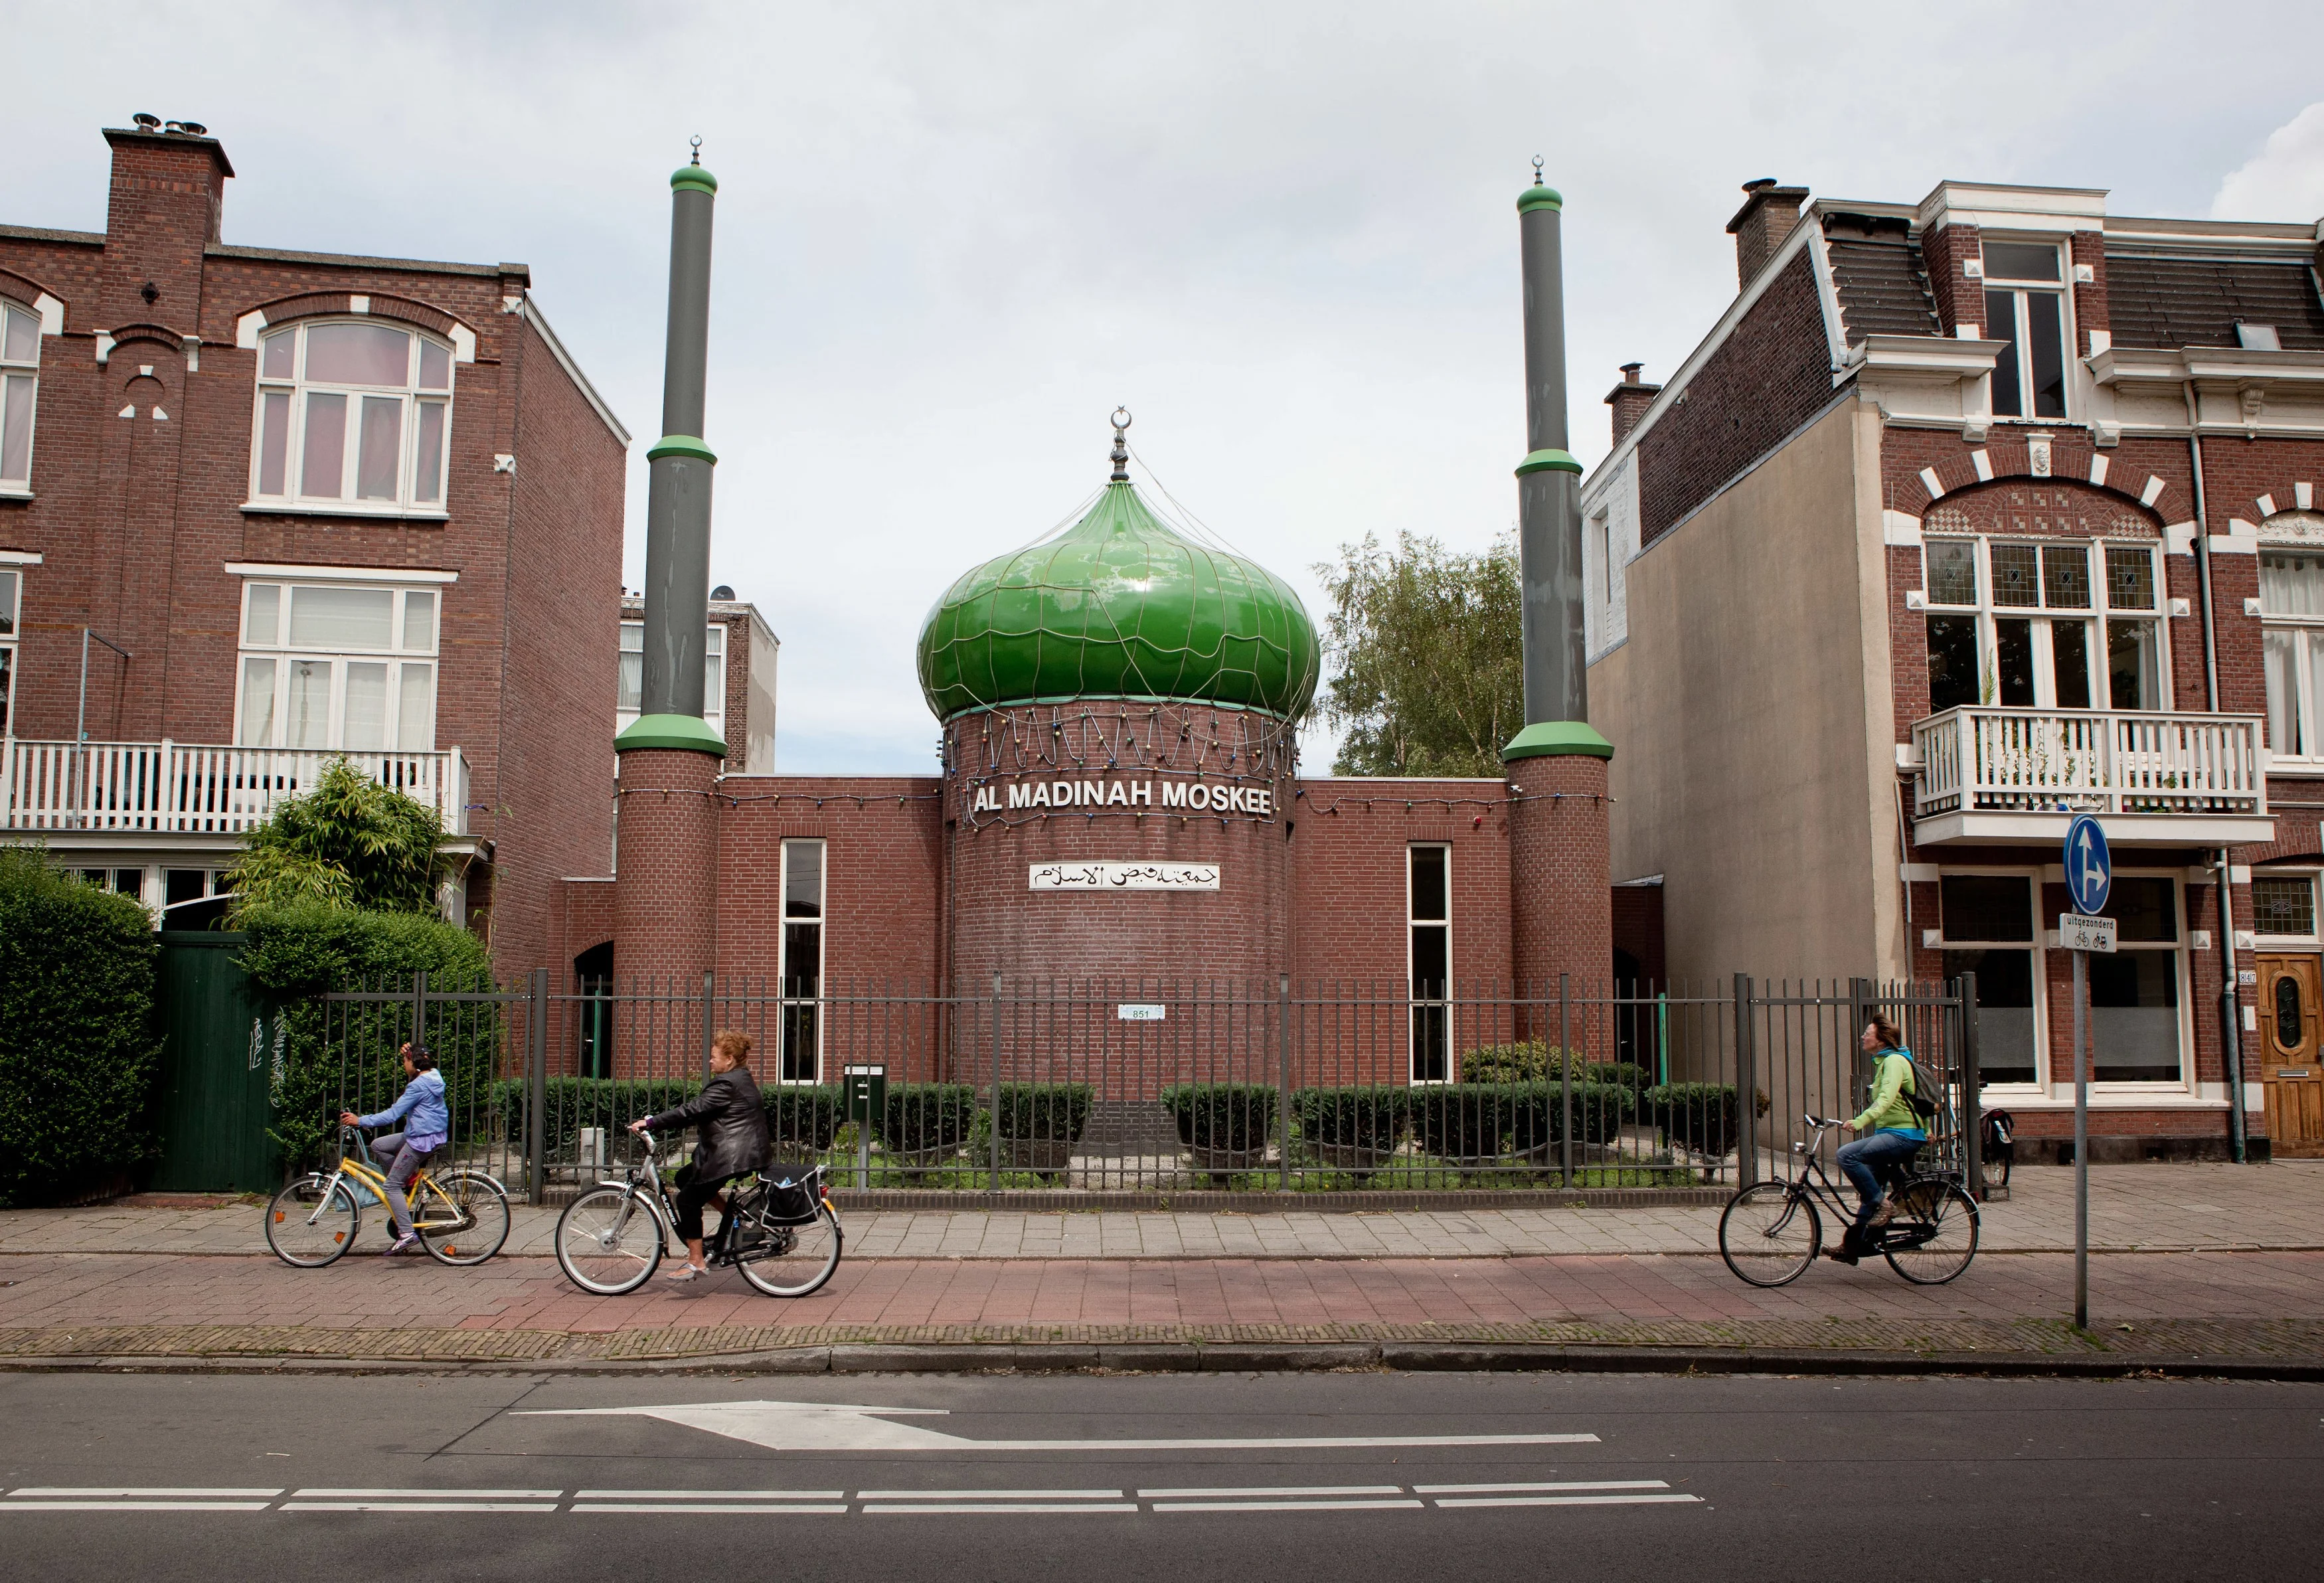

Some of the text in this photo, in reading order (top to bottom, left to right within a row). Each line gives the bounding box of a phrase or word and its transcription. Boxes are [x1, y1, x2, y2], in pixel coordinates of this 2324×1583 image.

[973, 780, 1271, 815] AL MADINAH MOSKEE
[2066, 916, 2114, 930] uitgezonderd
[2240, 973, 2256, 982] 847
